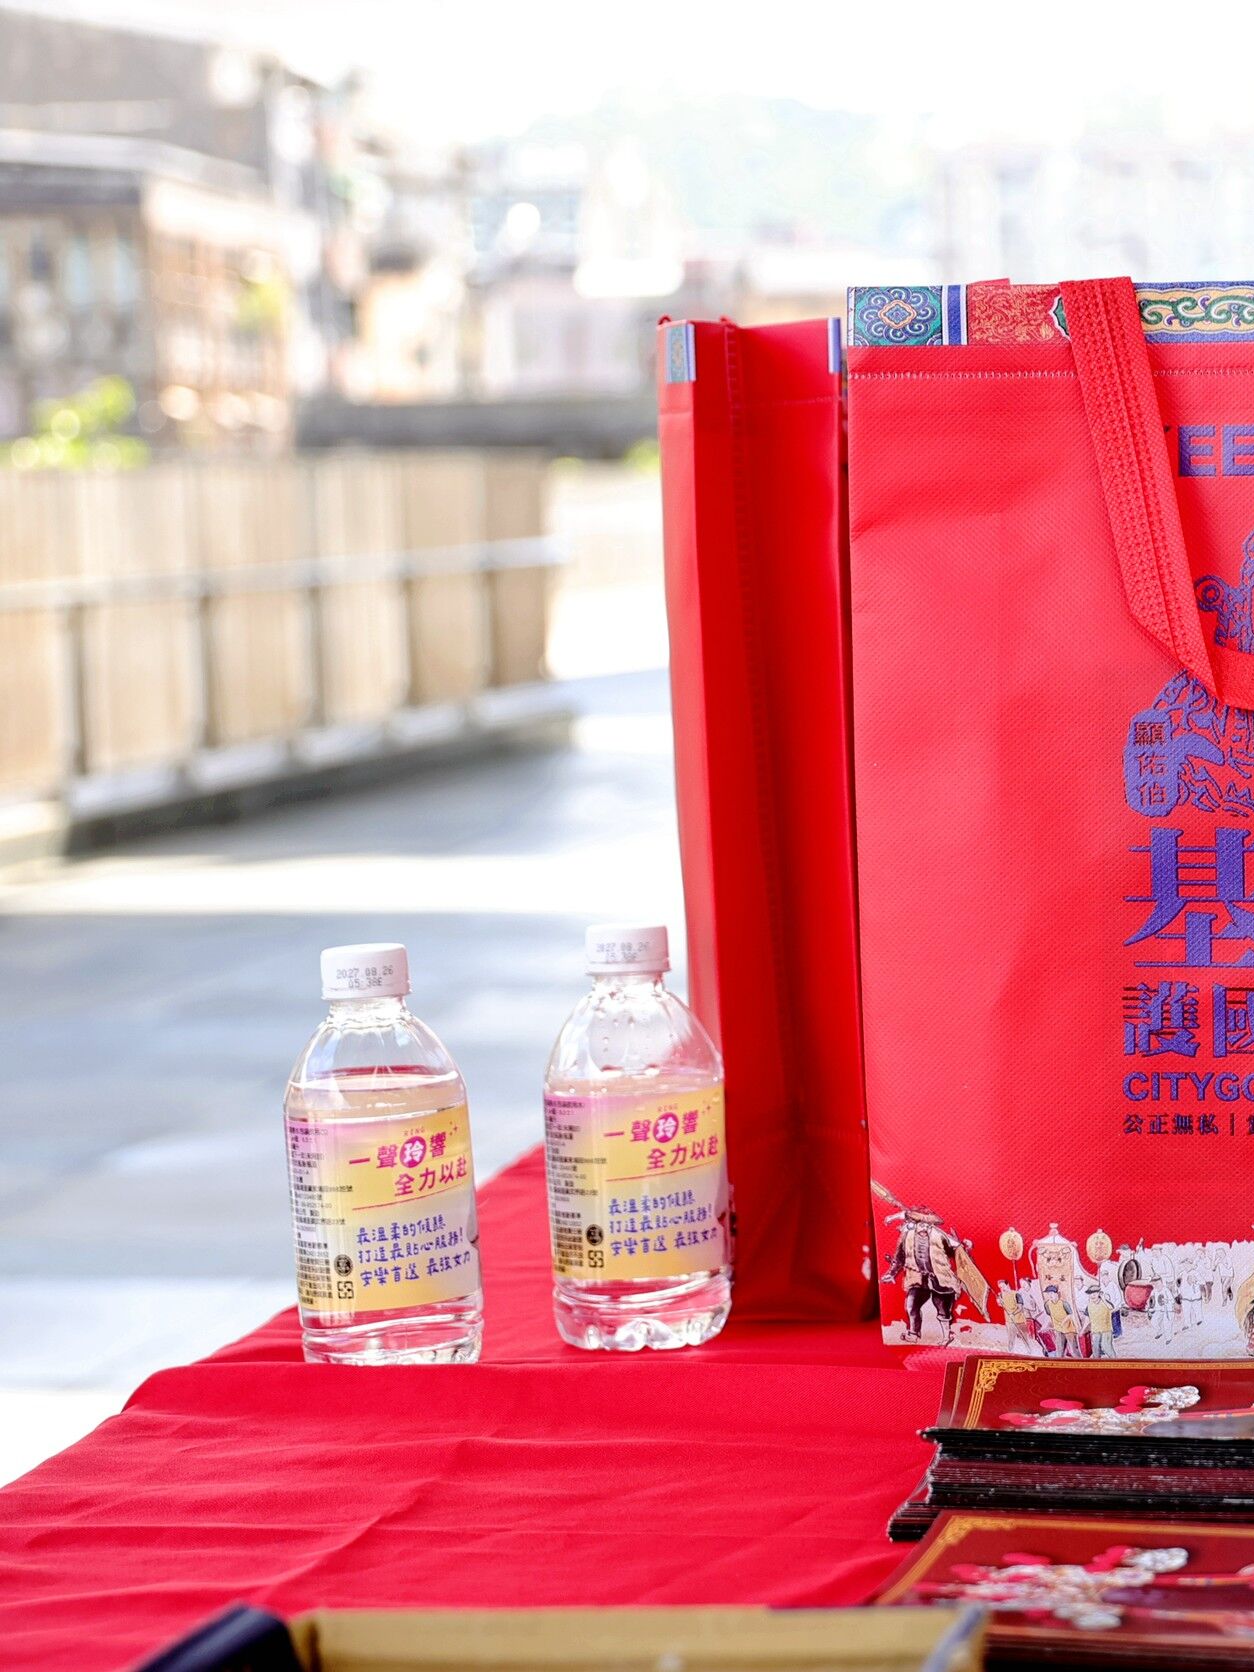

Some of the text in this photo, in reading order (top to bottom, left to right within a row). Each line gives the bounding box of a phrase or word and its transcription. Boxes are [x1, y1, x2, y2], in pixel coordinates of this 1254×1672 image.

[1122, 1113, 1219, 1135] 公正無私
[646, 1133, 719, 1171] 全力以赴
[394, 1155, 467, 1197] 全力以赴
